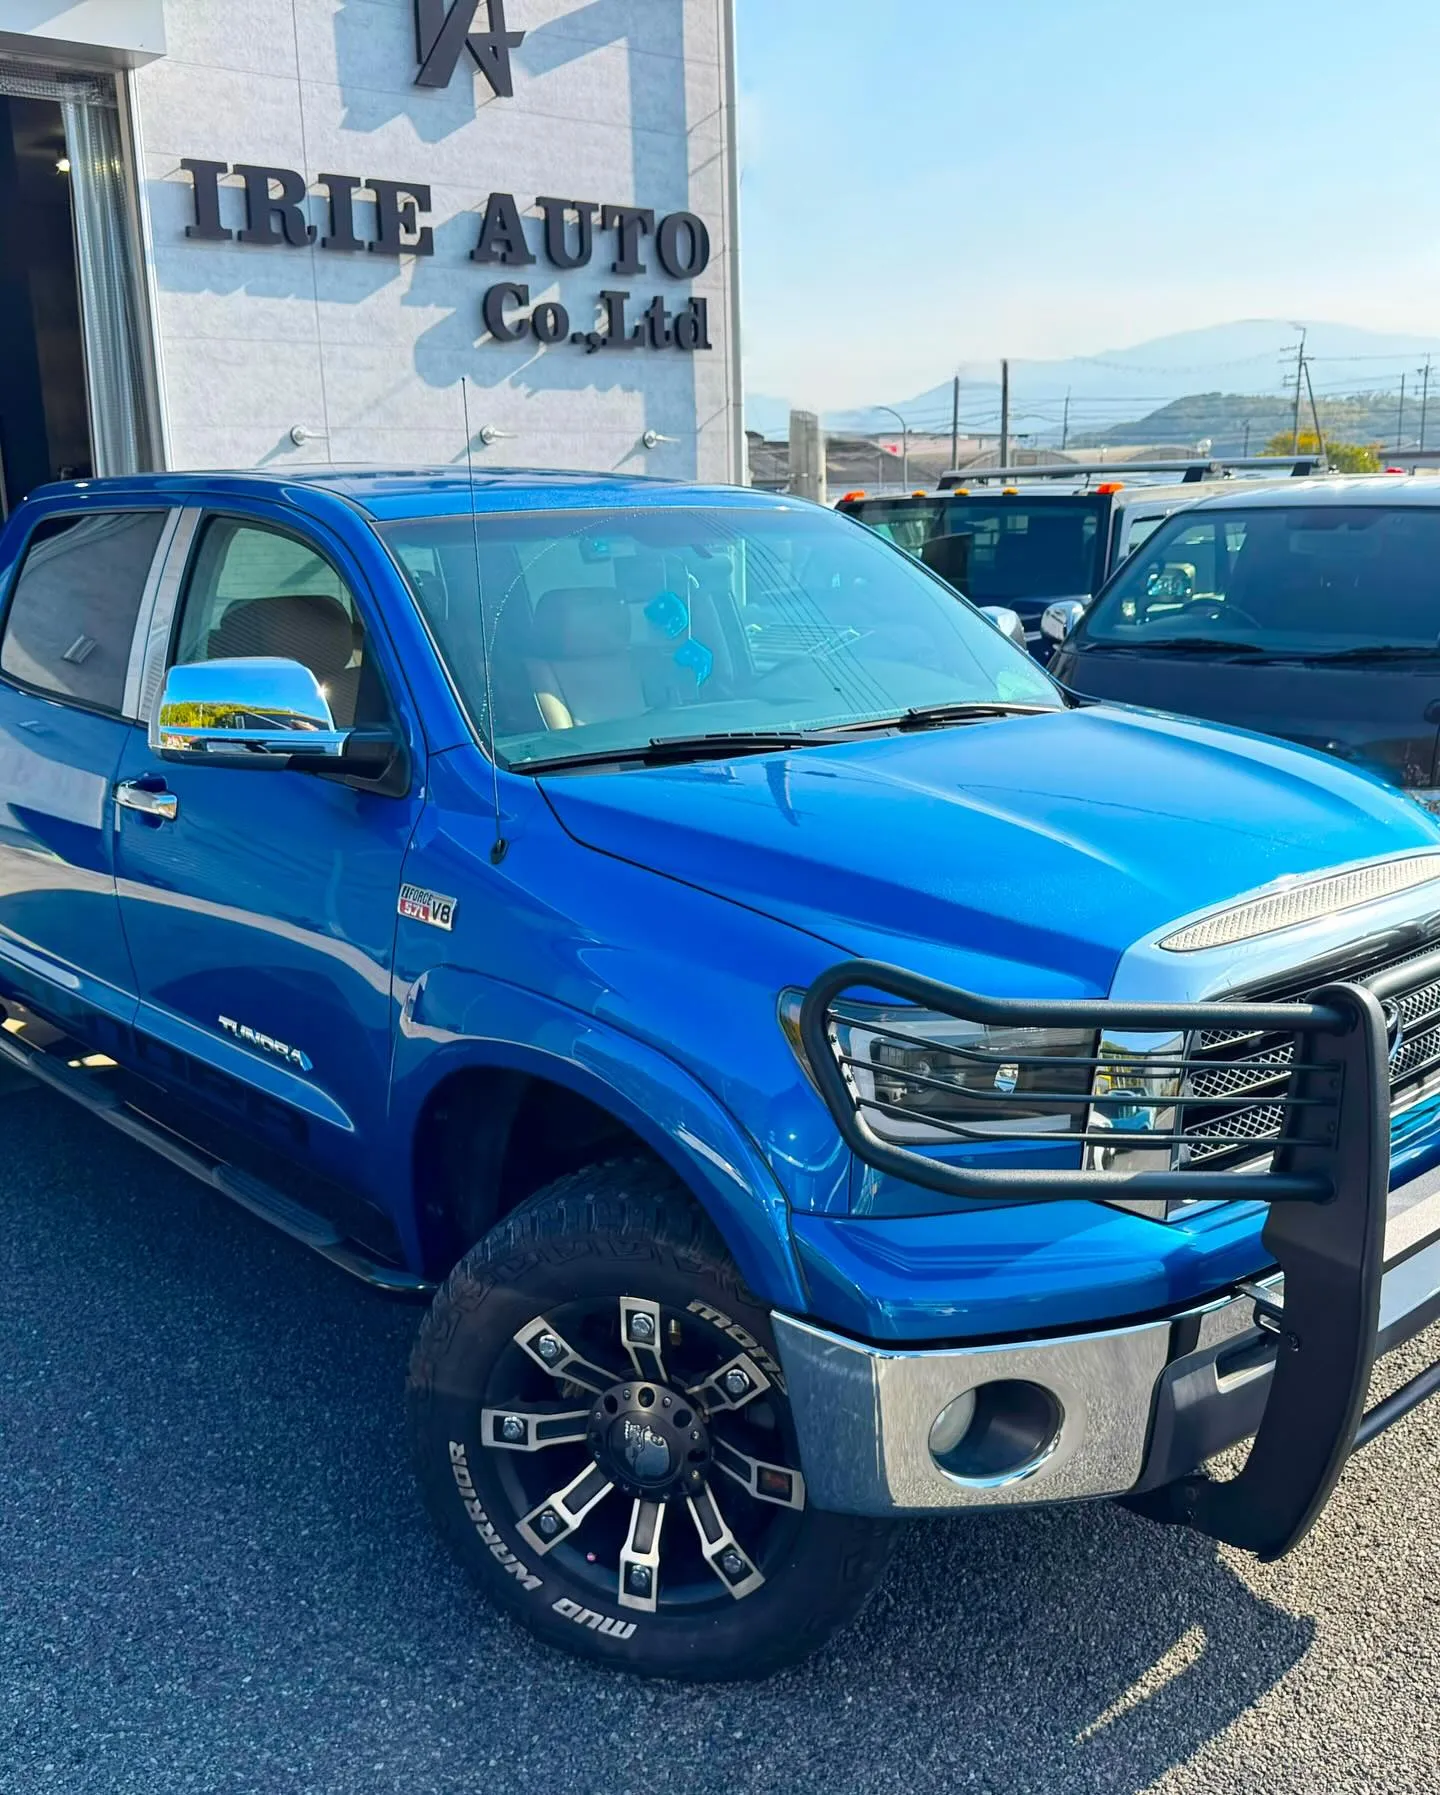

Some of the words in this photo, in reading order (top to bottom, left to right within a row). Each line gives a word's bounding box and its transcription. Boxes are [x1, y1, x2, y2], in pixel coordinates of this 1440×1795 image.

[180, 158, 434, 256] IRIE
[469, 192, 710, 279] AUTO
[482, 282, 712, 354] Co.,Ltd
[432, 901, 451, 924] V8
[218, 1015, 313, 1071] TUNDRA
[449, 1441, 543, 1591] WARRIOR
[552, 1598, 637, 1639] MUD
